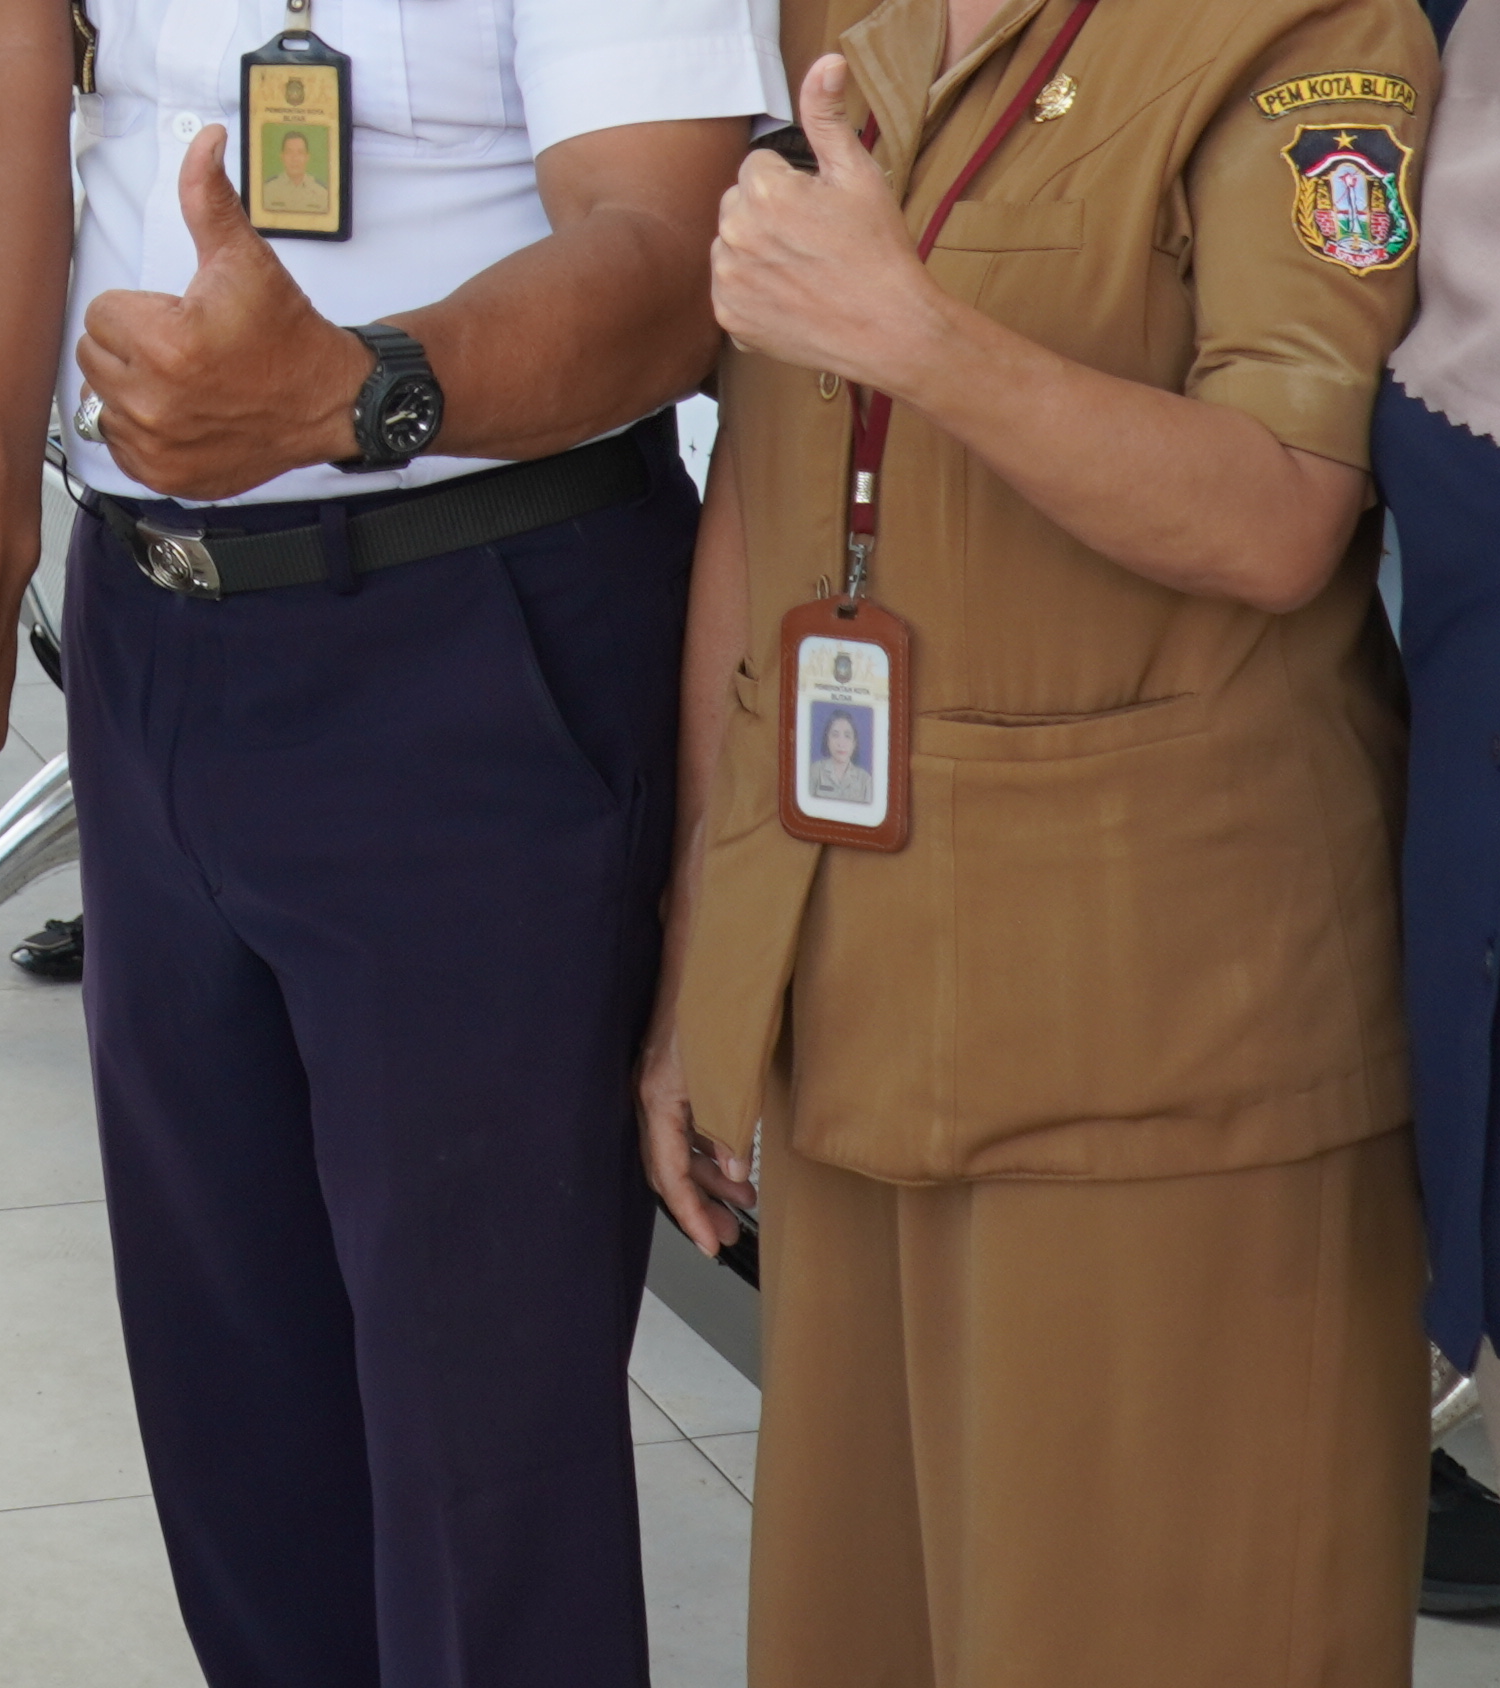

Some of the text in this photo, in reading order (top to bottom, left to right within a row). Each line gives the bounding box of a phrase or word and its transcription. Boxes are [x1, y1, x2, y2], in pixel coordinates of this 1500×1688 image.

[1265, 75, 1413, 114] PEM KOTA BLITAR
